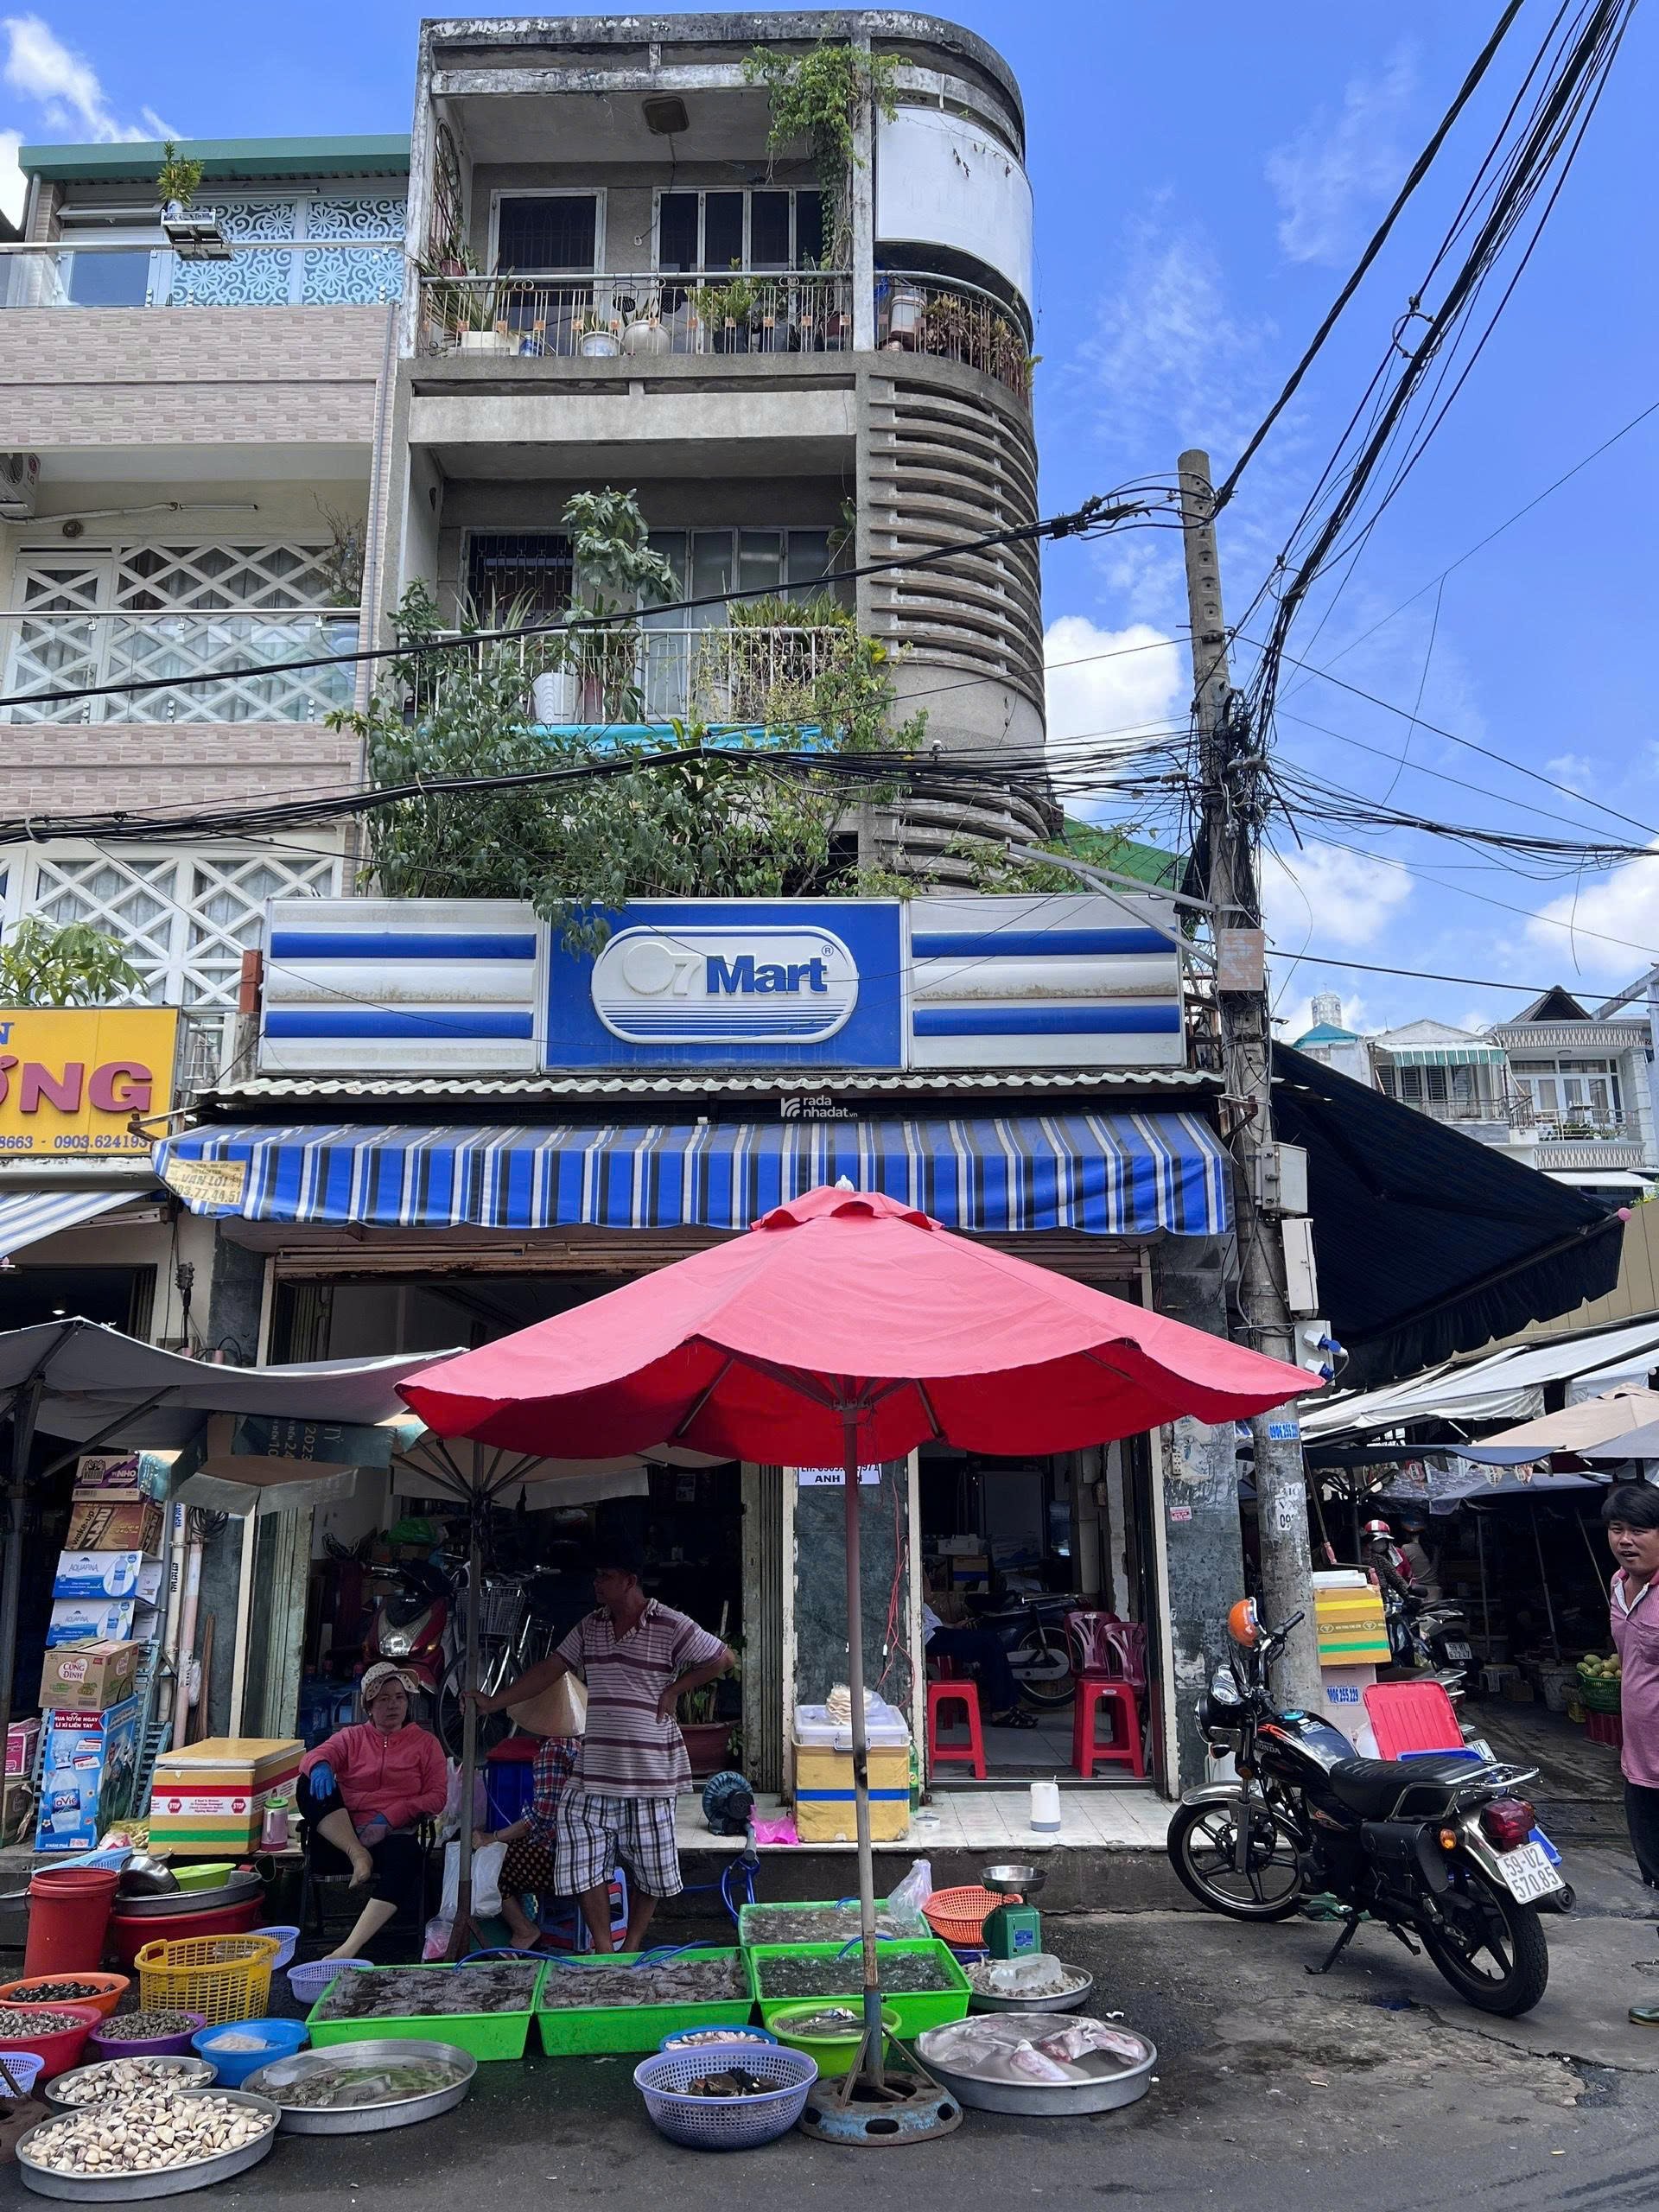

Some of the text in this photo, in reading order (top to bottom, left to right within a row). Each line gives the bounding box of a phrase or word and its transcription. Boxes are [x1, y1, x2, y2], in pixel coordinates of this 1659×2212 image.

[707, 955, 827, 993] Mart
[69, 1562, 99, 1573] AQUAFINA
[63, 1662, 85, 1672] CUNG
[1503, 1847, 1544, 1876] 59-U2
[1512, 1866, 1559, 1898] 570.85
